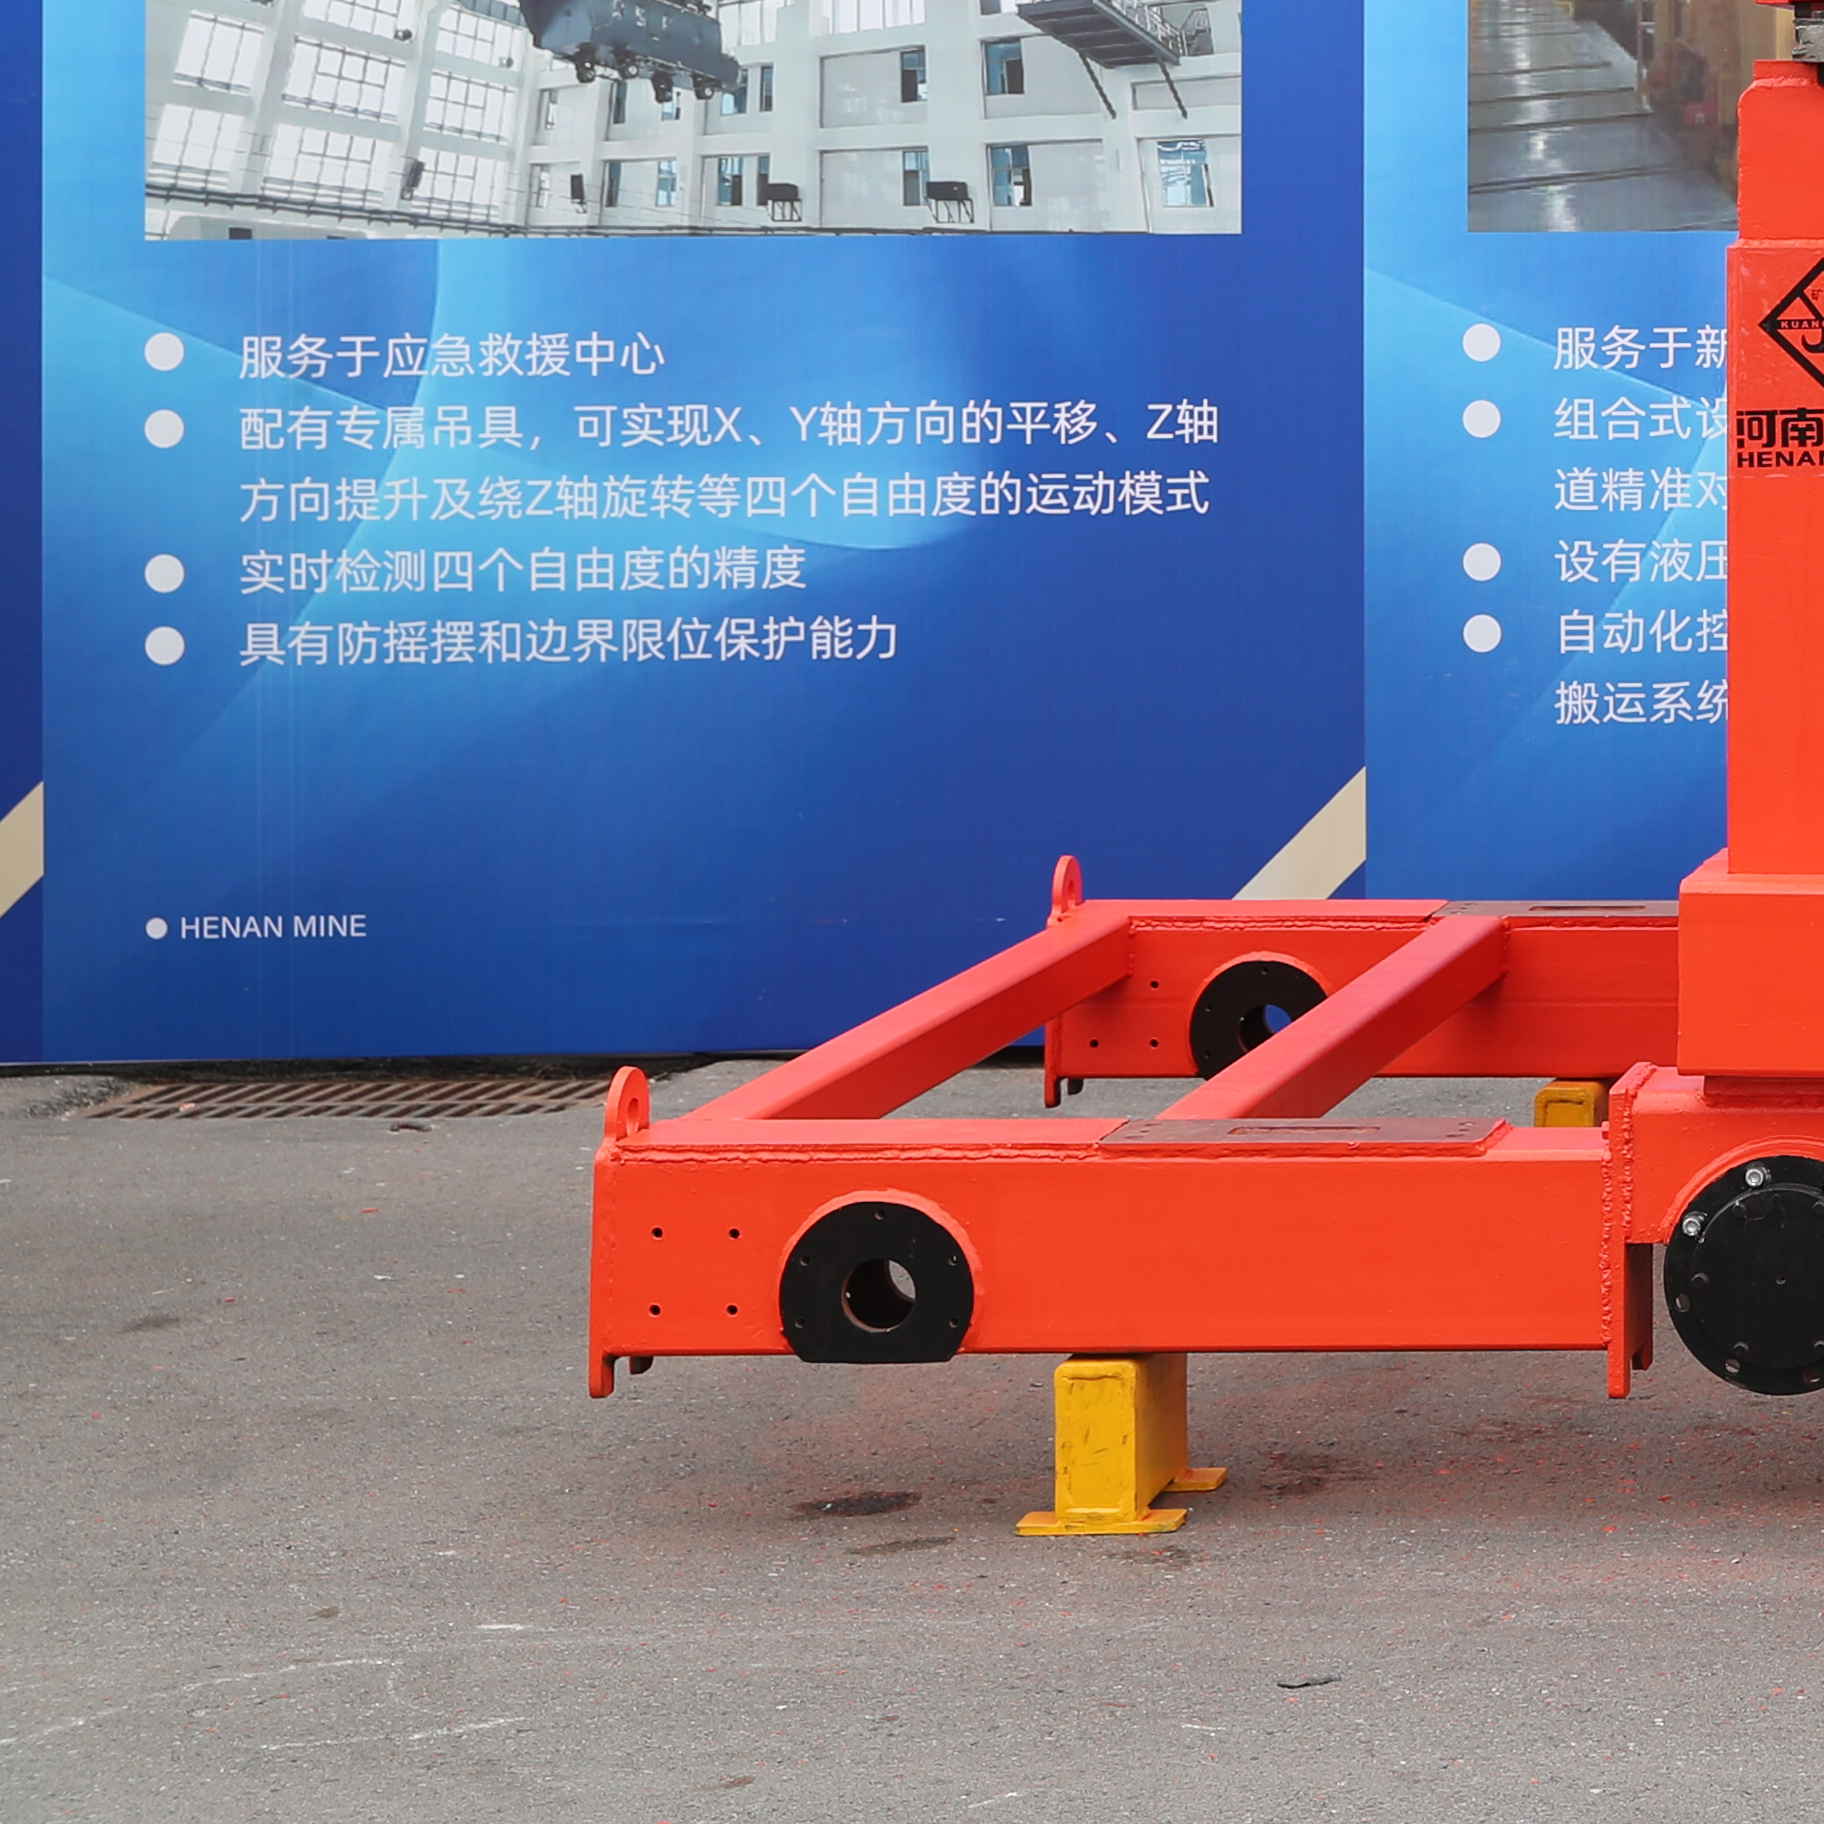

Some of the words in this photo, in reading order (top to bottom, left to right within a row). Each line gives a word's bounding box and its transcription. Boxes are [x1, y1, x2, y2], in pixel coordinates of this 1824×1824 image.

[239, 331, 666, 380] 服务于应急救援中心
[239, 470, 1211, 523] 方向提升及绕Z轴旋转等四个自由度的运动模式
[239, 544, 808, 596] 实时检测四个自由度的精度
[239, 614, 897, 667] 具有防摇摆和边界限位保护能力
[180, 915, 284, 939] HENAN
[293, 914, 367, 937] MINE
